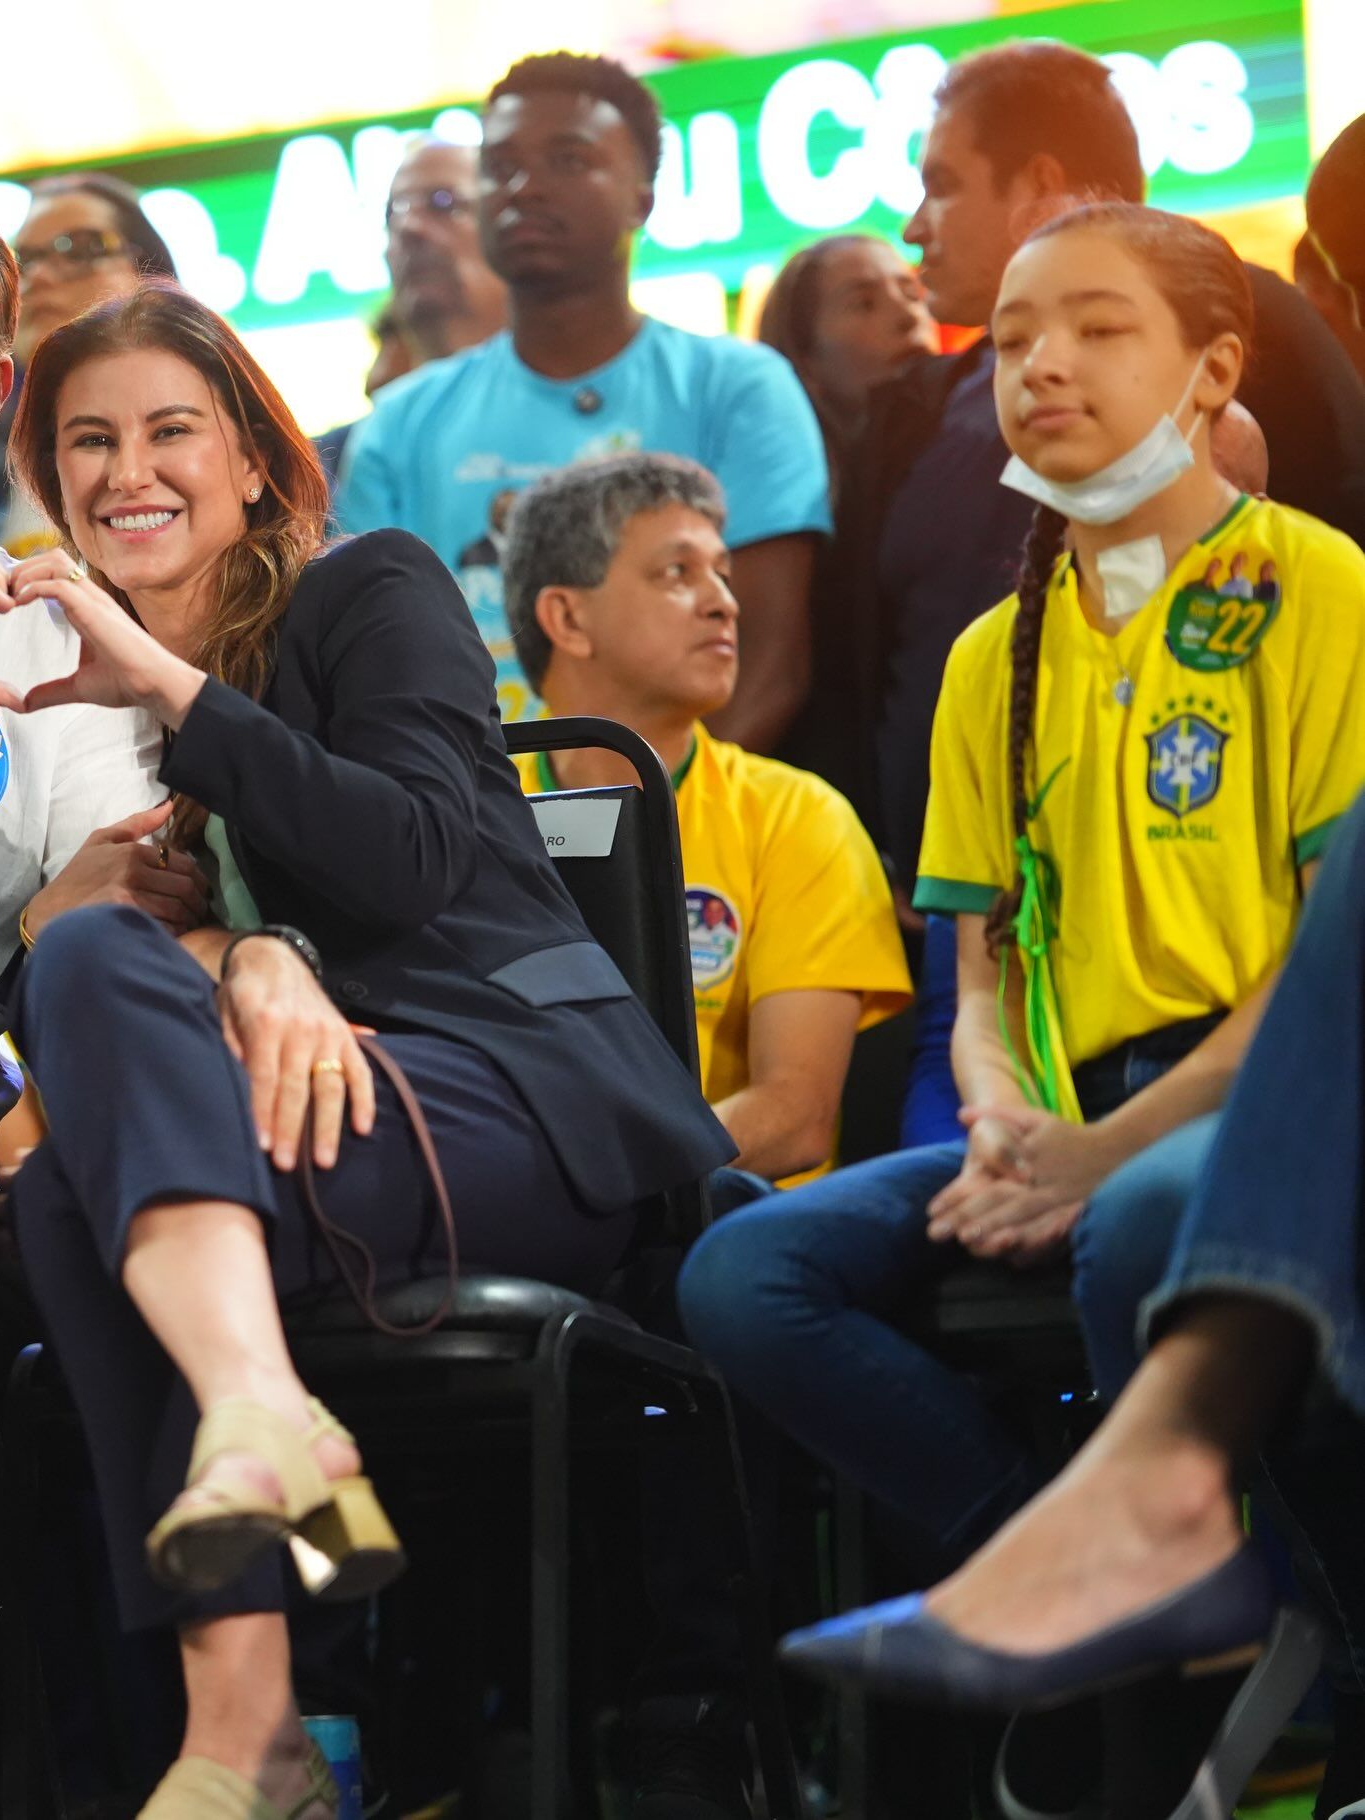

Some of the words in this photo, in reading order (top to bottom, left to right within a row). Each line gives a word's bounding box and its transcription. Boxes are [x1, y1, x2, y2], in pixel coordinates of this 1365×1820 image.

[1208, 600, 1266, 654] 22
[1147, 825, 1220, 841] BRASIL
[542, 836, 566, 847] RO
